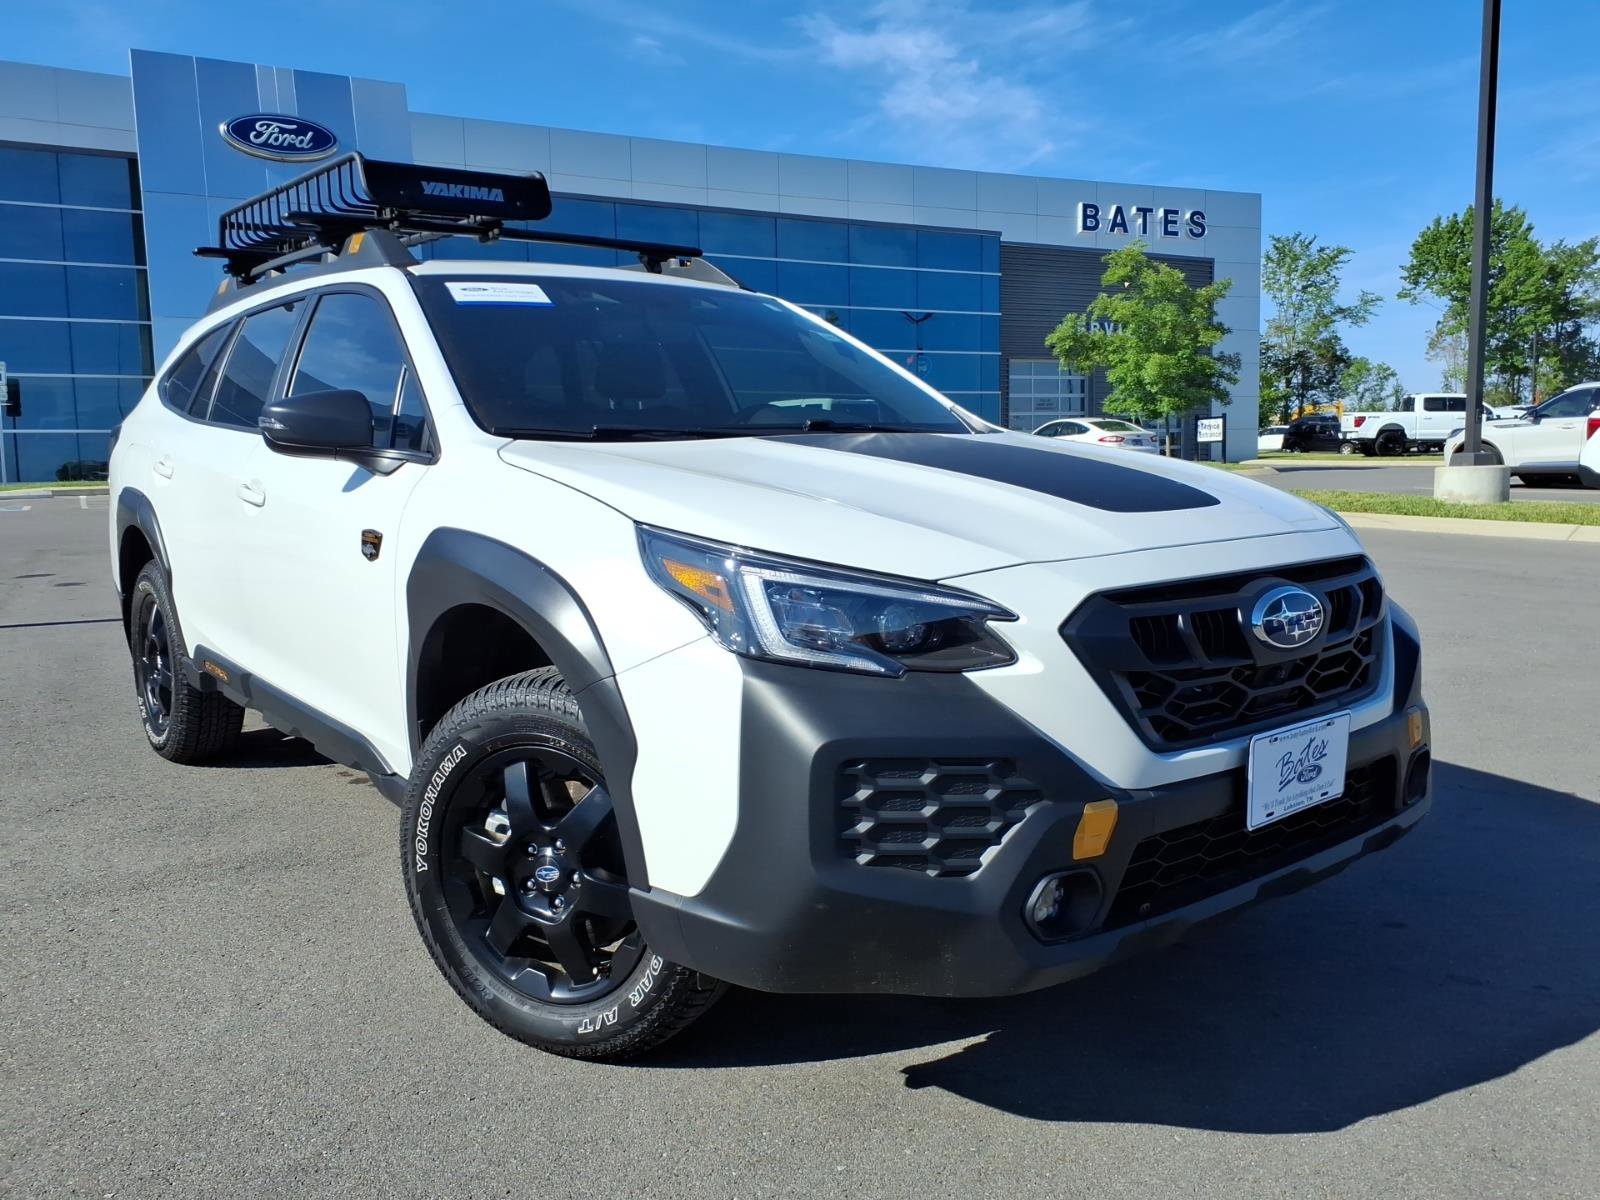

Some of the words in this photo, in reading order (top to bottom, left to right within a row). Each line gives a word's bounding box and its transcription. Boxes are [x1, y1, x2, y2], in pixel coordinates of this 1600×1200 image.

[250, 120, 314, 148] Ford
[420, 180, 504, 202] YAKIMA
[1077, 201, 1207, 239] BATES
[1275, 736, 1329, 791] Bates
[415, 744, 468, 873] YOKOHAMA
[628, 954, 664, 1007] DAR
[578, 1006, 618, 1034] A/T
